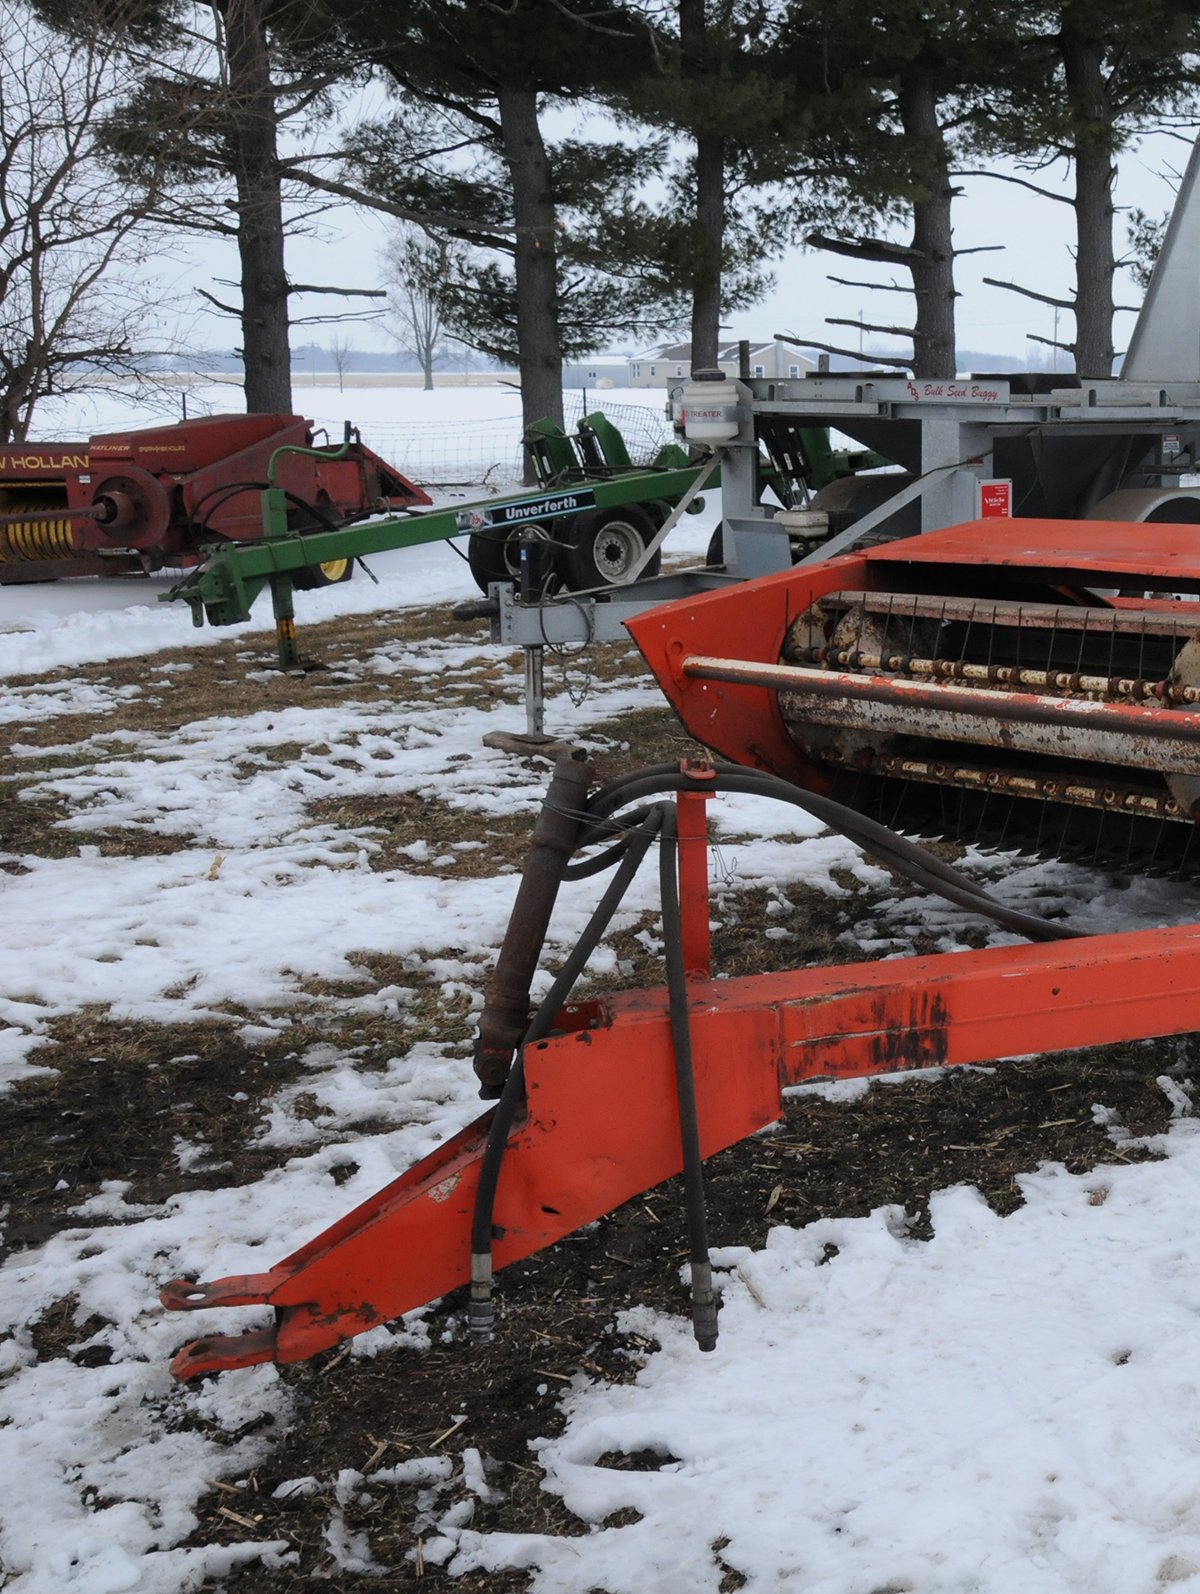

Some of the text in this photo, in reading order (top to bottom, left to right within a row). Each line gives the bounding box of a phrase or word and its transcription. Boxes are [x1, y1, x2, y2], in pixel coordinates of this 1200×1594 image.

[924, 384, 943, 396] Bulk
[947, 385, 967, 397] Seed
[971, 385, 998, 401] Buggy
[11, 455, 90, 469] HOLLAN
[505, 496, 577, 520] Unverferth
